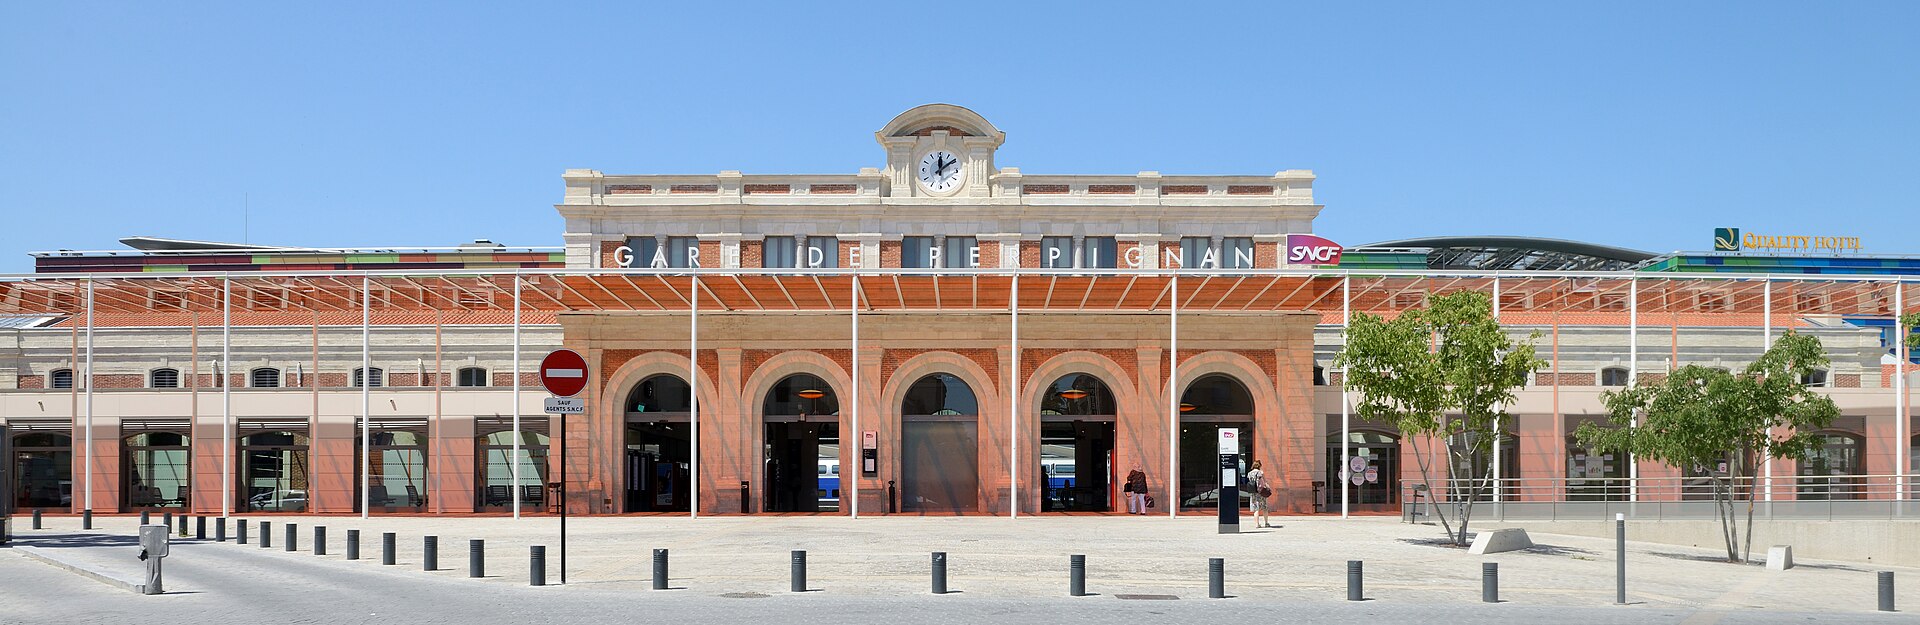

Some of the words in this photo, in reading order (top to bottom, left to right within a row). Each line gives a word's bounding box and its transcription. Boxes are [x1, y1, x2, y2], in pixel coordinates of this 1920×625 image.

[1743, 232, 1810, 249] QUALITY
[1814, 236, 1864, 250] HOTEL
[613, 246, 740, 267] GARE
[808, 246, 861, 267] DE
[929, 246, 1254, 267] PERPIGNAN
[1290, 245, 1340, 262] SNCF
